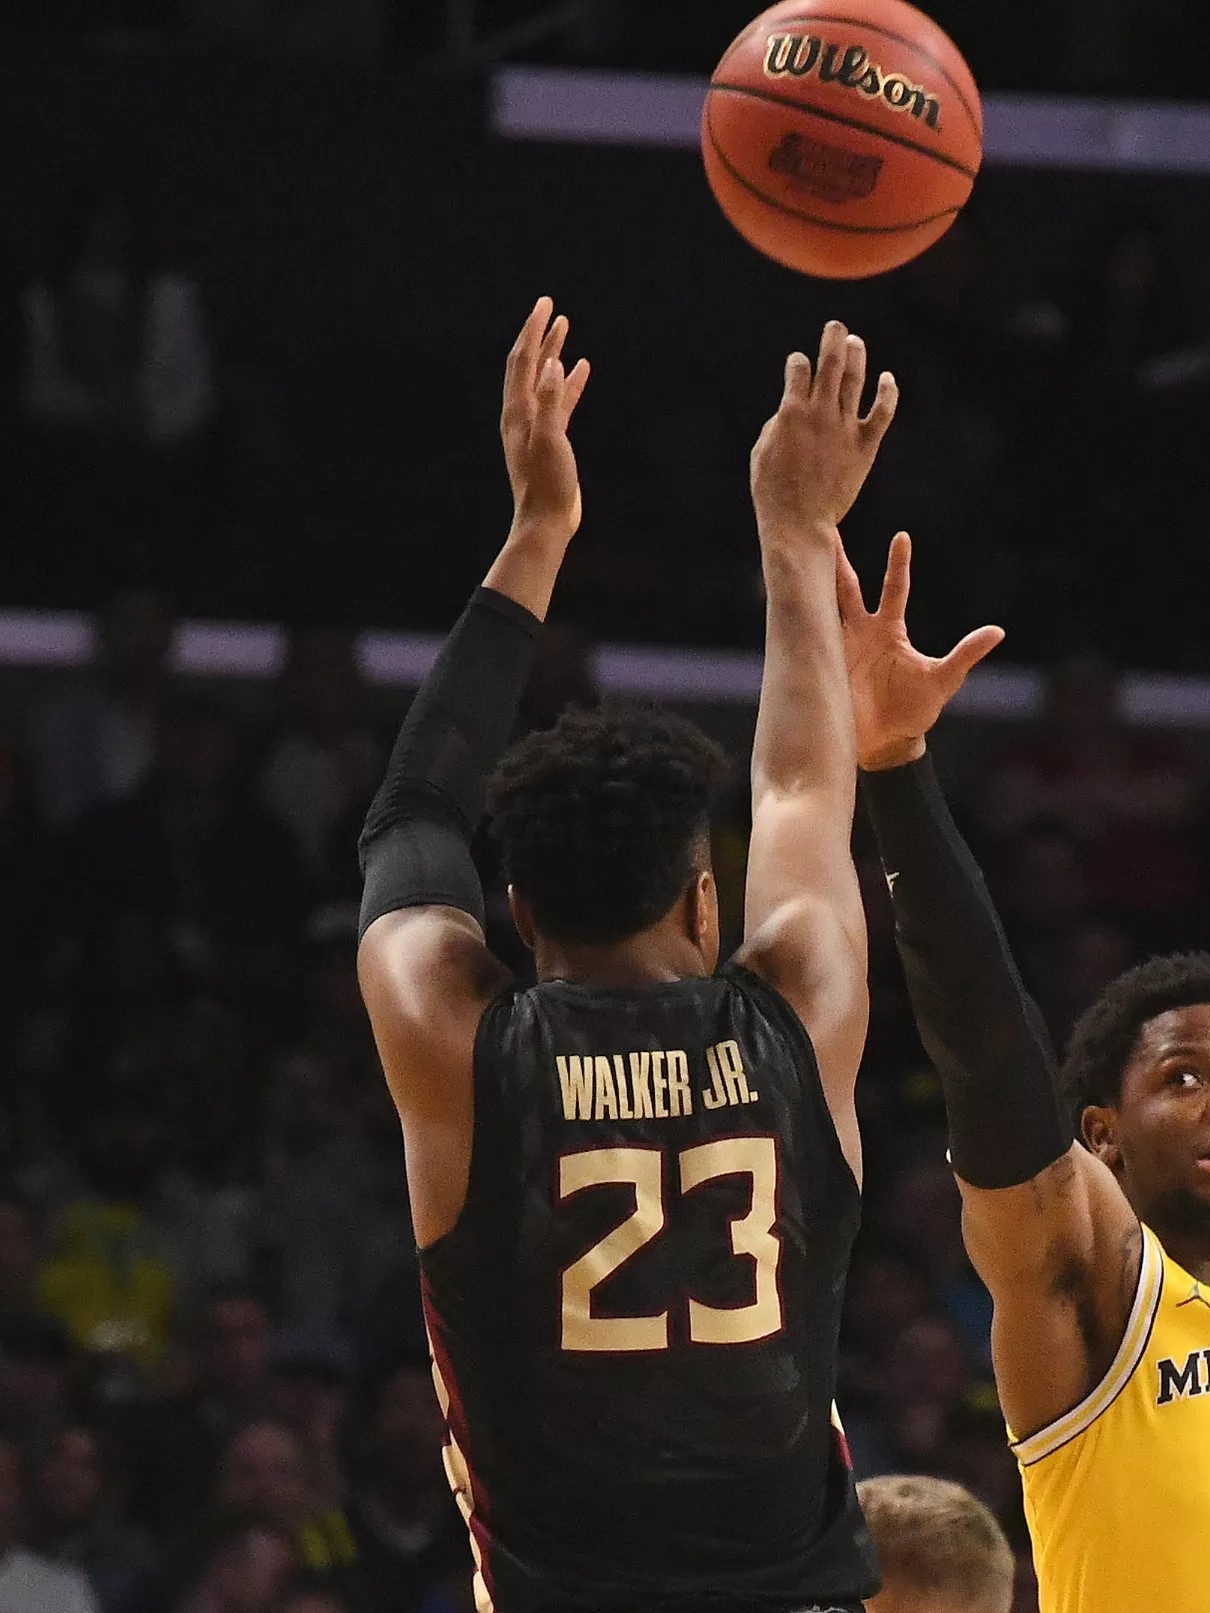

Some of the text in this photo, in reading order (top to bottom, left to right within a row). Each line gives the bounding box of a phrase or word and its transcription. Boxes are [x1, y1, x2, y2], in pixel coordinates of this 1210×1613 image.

[763, 33, 941, 130] Wilson
[556, 1039, 759, 1120] WALKER JR.
[557, 1134, 784, 1353] 23
